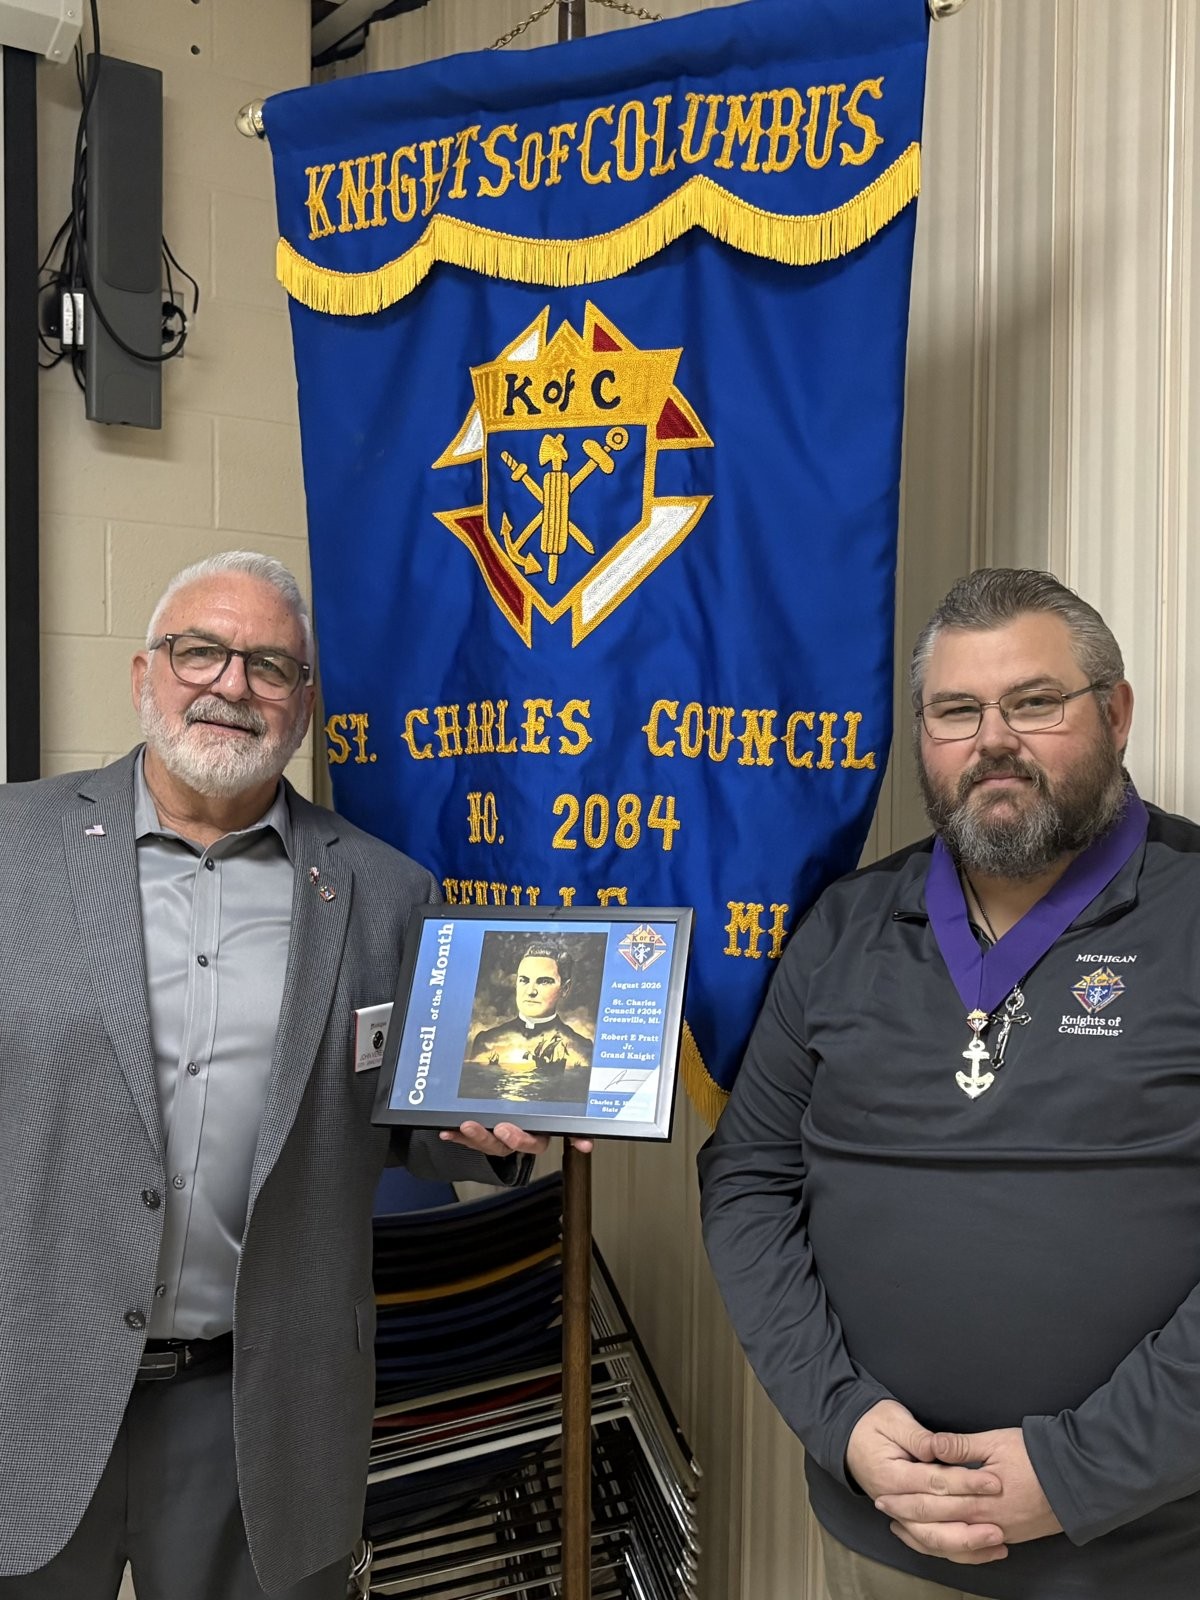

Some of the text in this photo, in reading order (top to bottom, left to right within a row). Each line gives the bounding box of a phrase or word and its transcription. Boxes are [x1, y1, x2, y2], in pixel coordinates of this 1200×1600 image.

[304, 76, 886, 240] KNIGHTS OF COLUMBUS
[503, 368, 621, 416] K of C
[325, 698, 876, 769] ST. CHARLES COUNCIL
[467, 792, 681, 851] NO. 2084
[1075, 954, 1137, 963] MICHIGAN
[611, 981, 639, 990] August
[408, 922, 455, 1105] Council of the Month
[604, 1007, 635, 1015] Council
[603, 1016, 646, 1025] Greenville,
[1061, 1015, 1122, 1027] Knights of
[601, 1033, 628, 1041] Robert
[638, 1034, 659, 1042] Pratt
[600, 1051, 655, 1061] Grand Knight
